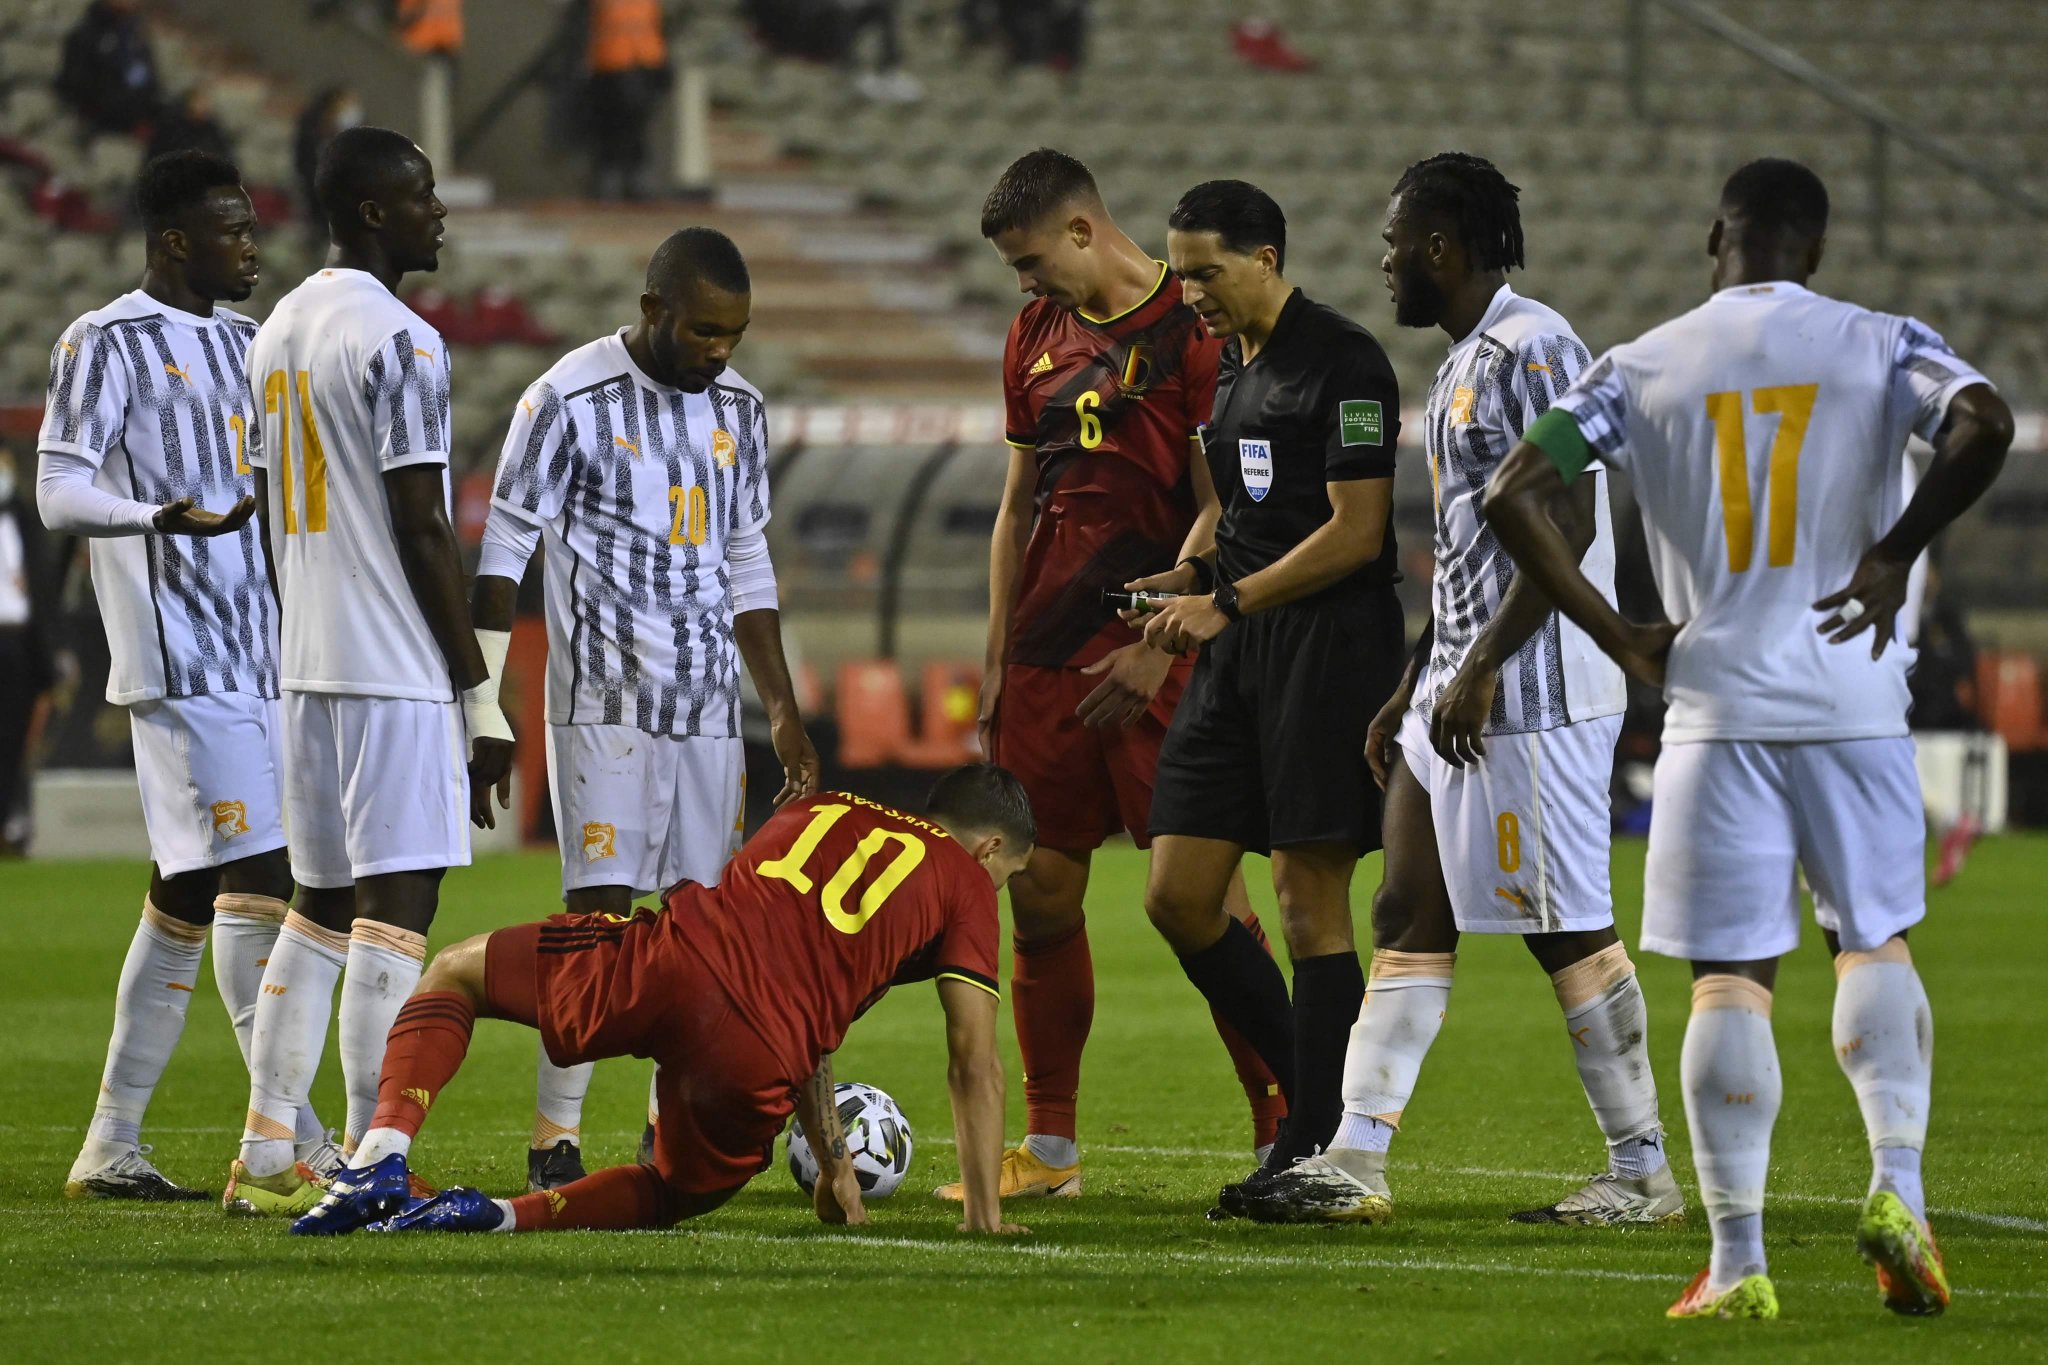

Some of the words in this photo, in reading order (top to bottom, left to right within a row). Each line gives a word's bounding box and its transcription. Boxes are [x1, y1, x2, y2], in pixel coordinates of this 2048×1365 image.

[1030, 364, 1053, 374] adidas
[1075, 390, 1103, 449] 6
[265, 369, 328, 535] 21
[1241, 444, 1268, 459] FIFA
[1243, 467, 1270, 477] REFEREE
[1705, 383, 1819, 574] 17
[668, 485, 706, 546] 20
[1251, 488, 1264, 496] 2020
[756, 803, 926, 934] 10
[1497, 811, 1520, 873] 8
